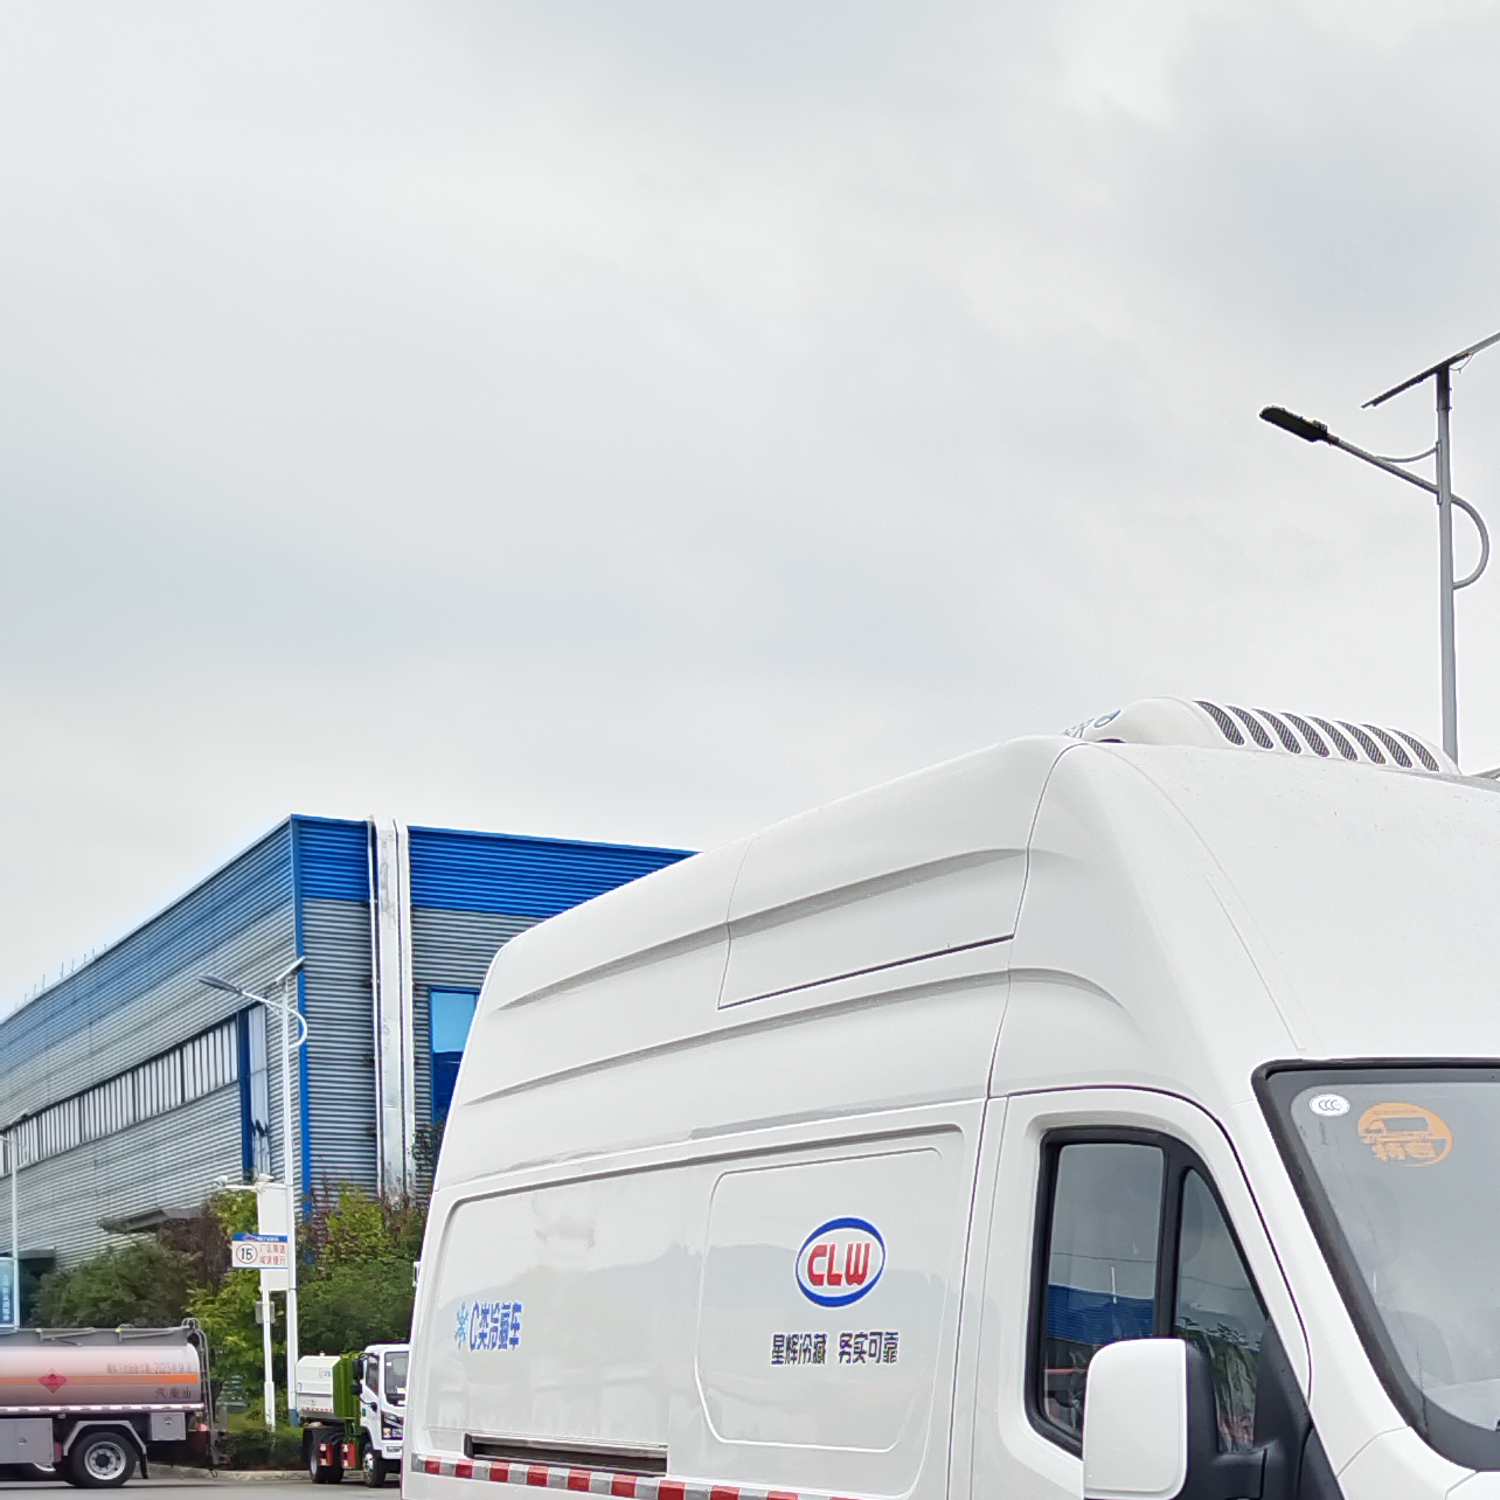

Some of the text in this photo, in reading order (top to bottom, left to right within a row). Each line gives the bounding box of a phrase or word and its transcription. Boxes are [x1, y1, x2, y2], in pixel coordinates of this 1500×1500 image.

[807, 1242, 871, 1286] CLW
[470, 1301, 522, 1350] C类冷藏车
[771, 1332, 899, 1365] 星辉冷藏 务实可靠
